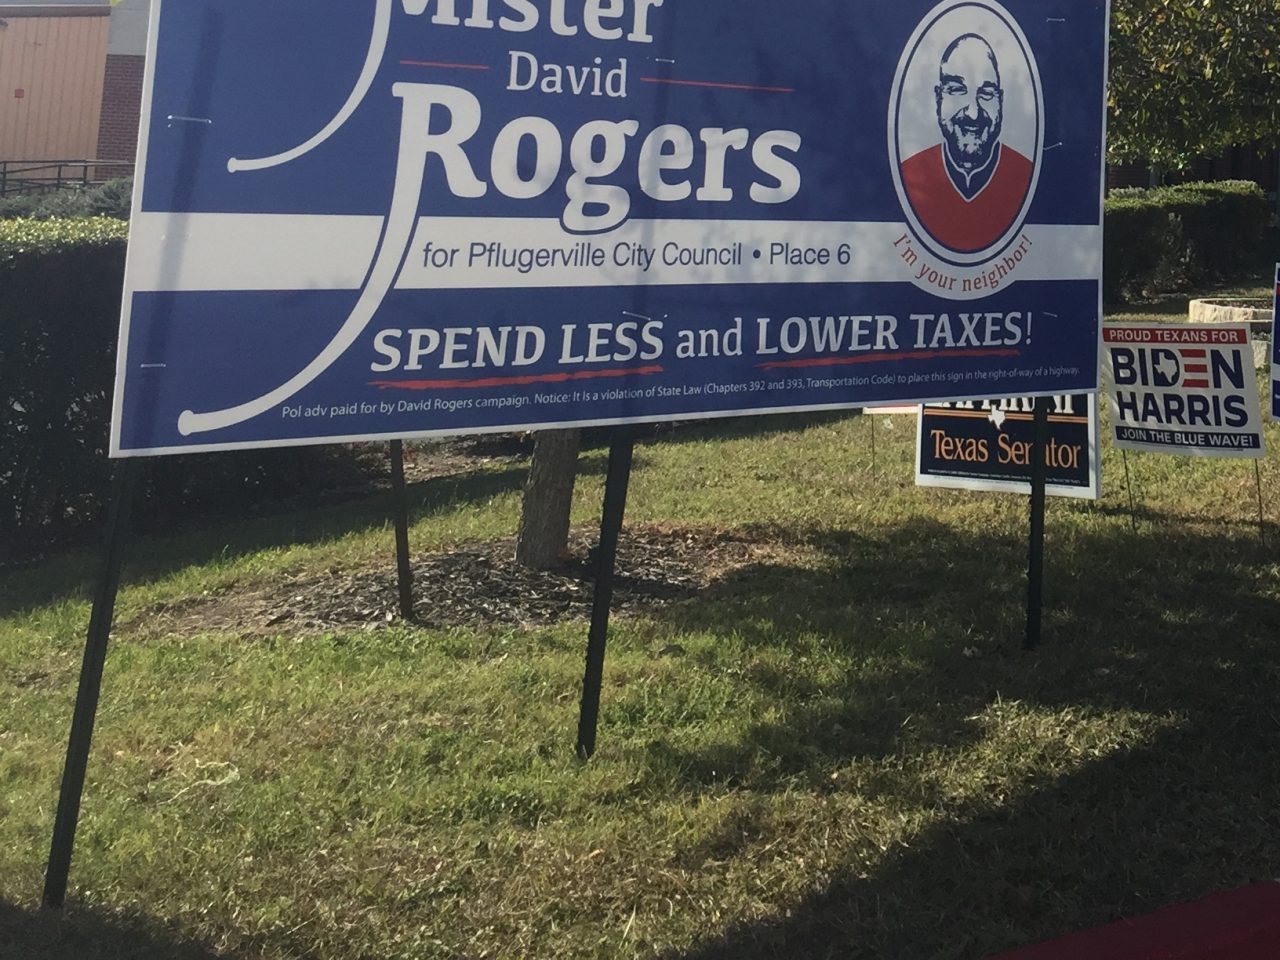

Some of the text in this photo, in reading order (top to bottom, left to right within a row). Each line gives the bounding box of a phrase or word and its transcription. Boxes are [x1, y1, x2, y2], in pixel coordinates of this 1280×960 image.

[506, 50, 627, 98] David
[423, 242, 851, 272] for Pflugerville City Council Place 6
[893, 233, 1033, 292] I'm your neighbor!
[370, 311, 1032, 372] SPEND LESS and LOWER TAXES!
[1109, 329, 1238, 342] PROUD TEXANS FOR
[1110, 347, 1245, 389] BIDEN
[282, 406, 301, 418] Pol
[304, 404, 327, 416] adv
[330, 402, 357, 418] paid
[360, 401, 377, 413] for
[380, 401, 395, 415] by
[397, 399, 432, 412] David
[434, 398, 473, 414] Rogers
[475, 394, 532, 410] campaign.
[534, 393, 571, 404] Notice:
[573, 391, 581, 402] It
[583, 391, 590, 402] is
[592, 393, 599, 401] a
[600, 388, 643, 401] violation
[646, 386, 656, 399] of
[657, 386, 681, 398] State
[683, 385, 701, 396] Law
[703, 382, 747, 394] (Chapters
[749, 380, 765, 391] 392
[767, 379, 784, 390] and
[806, 375, 869, 389] Transportation
[870, 373, 896, 385] Code)
[897, 373, 907, 383] to
[908, 371, 930, 384] place
[931, 370, 946, 381] this
[947, 370, 964, 383] sign
[965, 369, 973, 379] in
[975, 368, 988, 379] the
[988, 367, 1034, 380] right-of-way
[1034, 366, 1043, 377] of
[1049, 365, 1081, 378] highway.
[1116, 390, 1249, 428] HARRIS
[930, 429, 989, 463] Texas
[1121, 428, 1148, 440] JOIN
[1149, 430, 1171, 443] THE
[1174, 432, 1205, 446] BLUE
[1208, 434, 1253, 448] WAVE!
